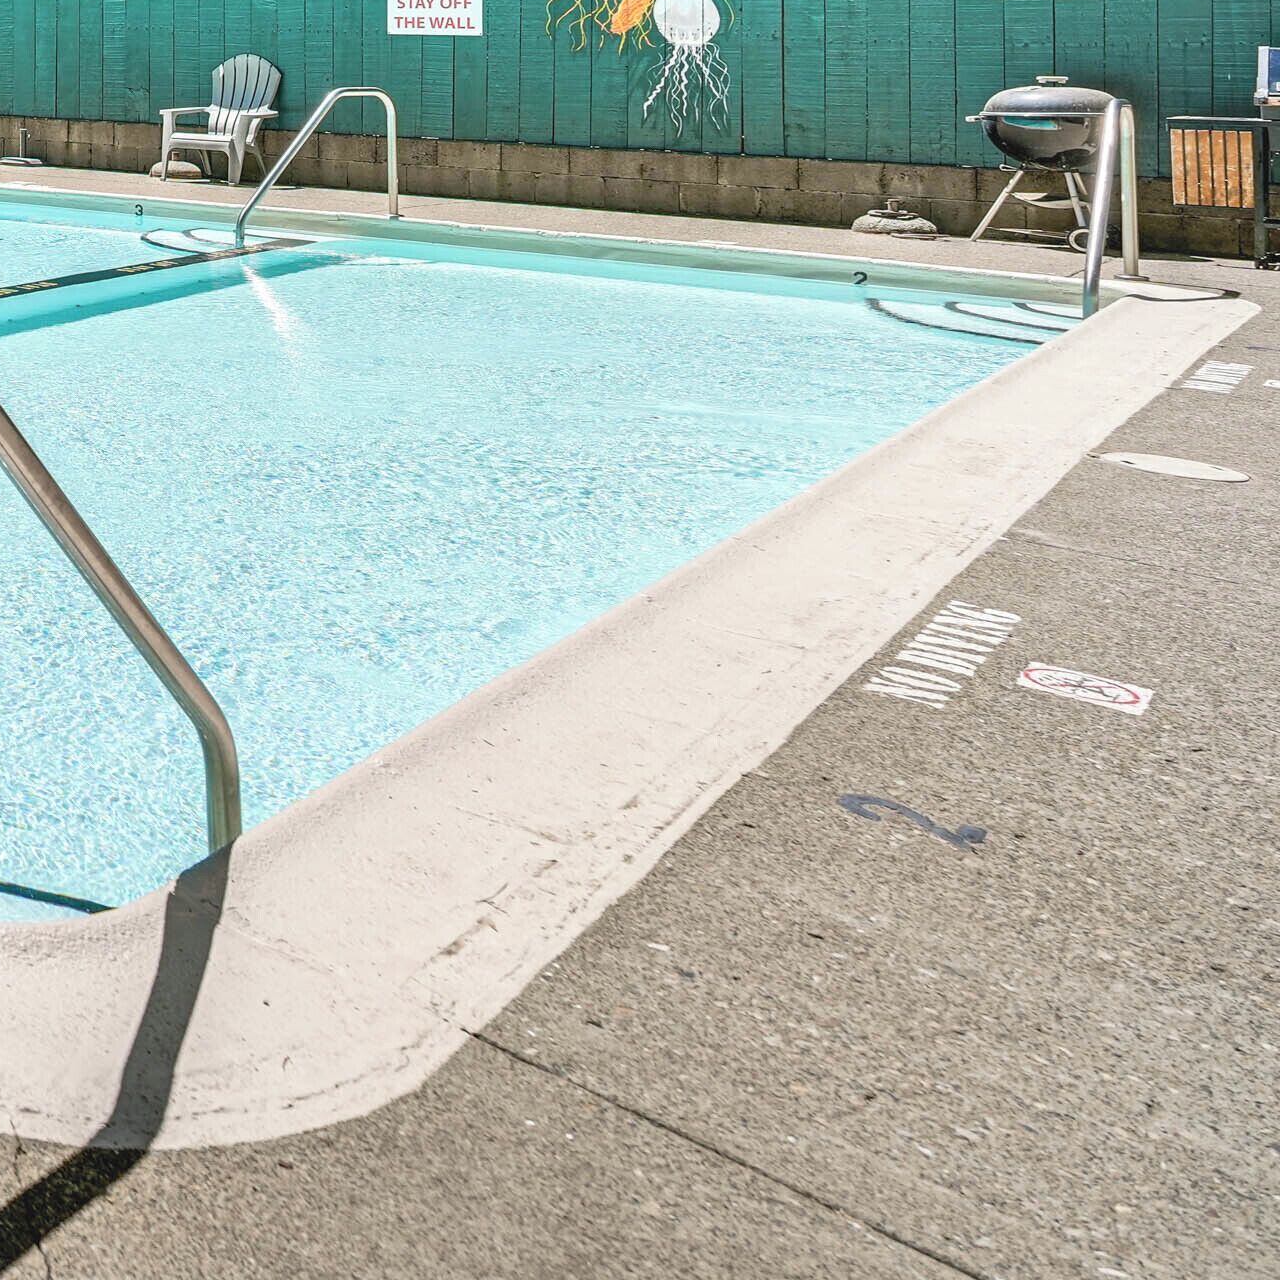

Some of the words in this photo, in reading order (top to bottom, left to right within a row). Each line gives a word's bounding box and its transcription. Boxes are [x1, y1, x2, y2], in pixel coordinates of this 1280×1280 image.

[394, 17, 426, 29] THE
[429, 17, 475, 29] WALL
[135, 204, 144, 216] 3
[853, 271, 867, 284] 2
[896, 600, 1022, 677] DIVING
[863, 666, 964, 709] NO
